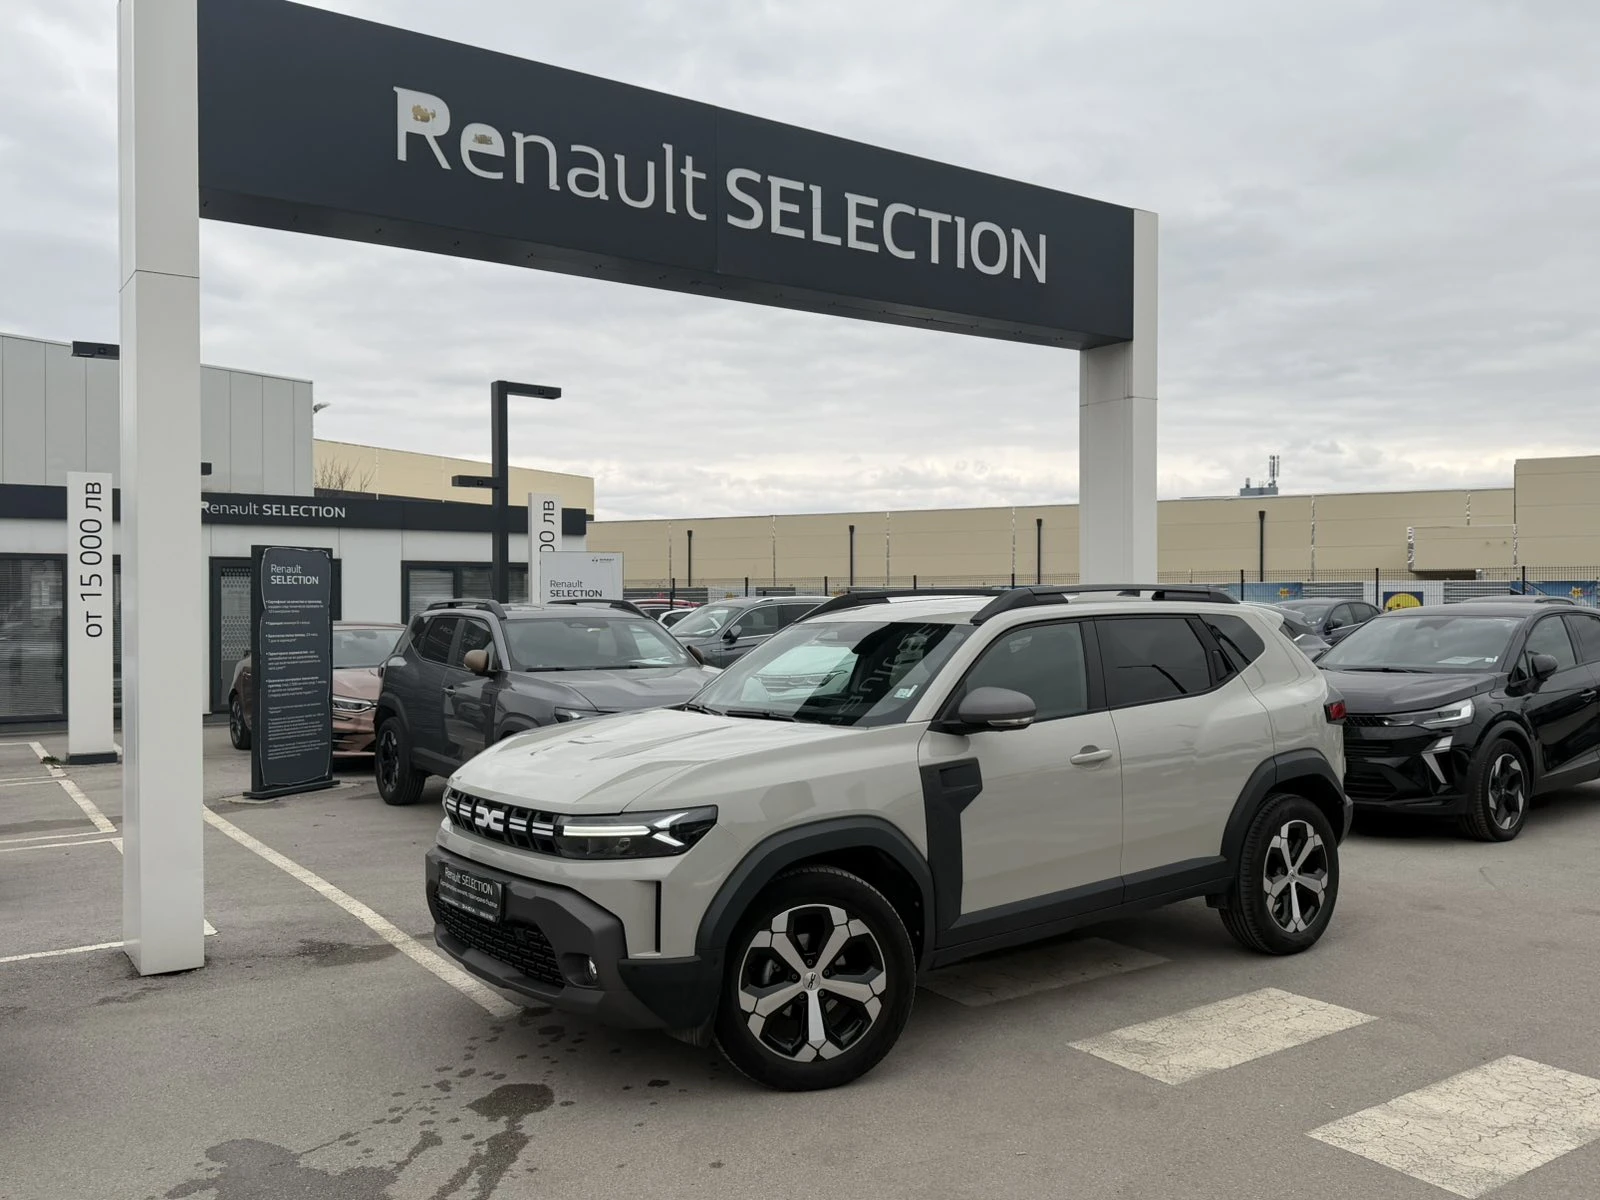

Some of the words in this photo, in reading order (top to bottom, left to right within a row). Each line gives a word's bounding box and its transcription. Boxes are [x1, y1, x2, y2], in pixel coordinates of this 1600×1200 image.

[393, 86, 707, 221] Renault
[726, 167, 1047, 284] SELECTION
[201, 501, 259, 515] Renault
[262, 503, 345, 518] SELECTION
[80, 518, 102, 565] 000
[270, 563, 302, 574] Renault
[80, 573, 102, 602] 15
[270, 575, 319, 585] SELECTION
[550, 579, 583, 588] Renault
[550, 589, 603, 598] SELECTION
[445, 866, 461, 884] Renault
[461, 874, 493, 896] SELECTION
